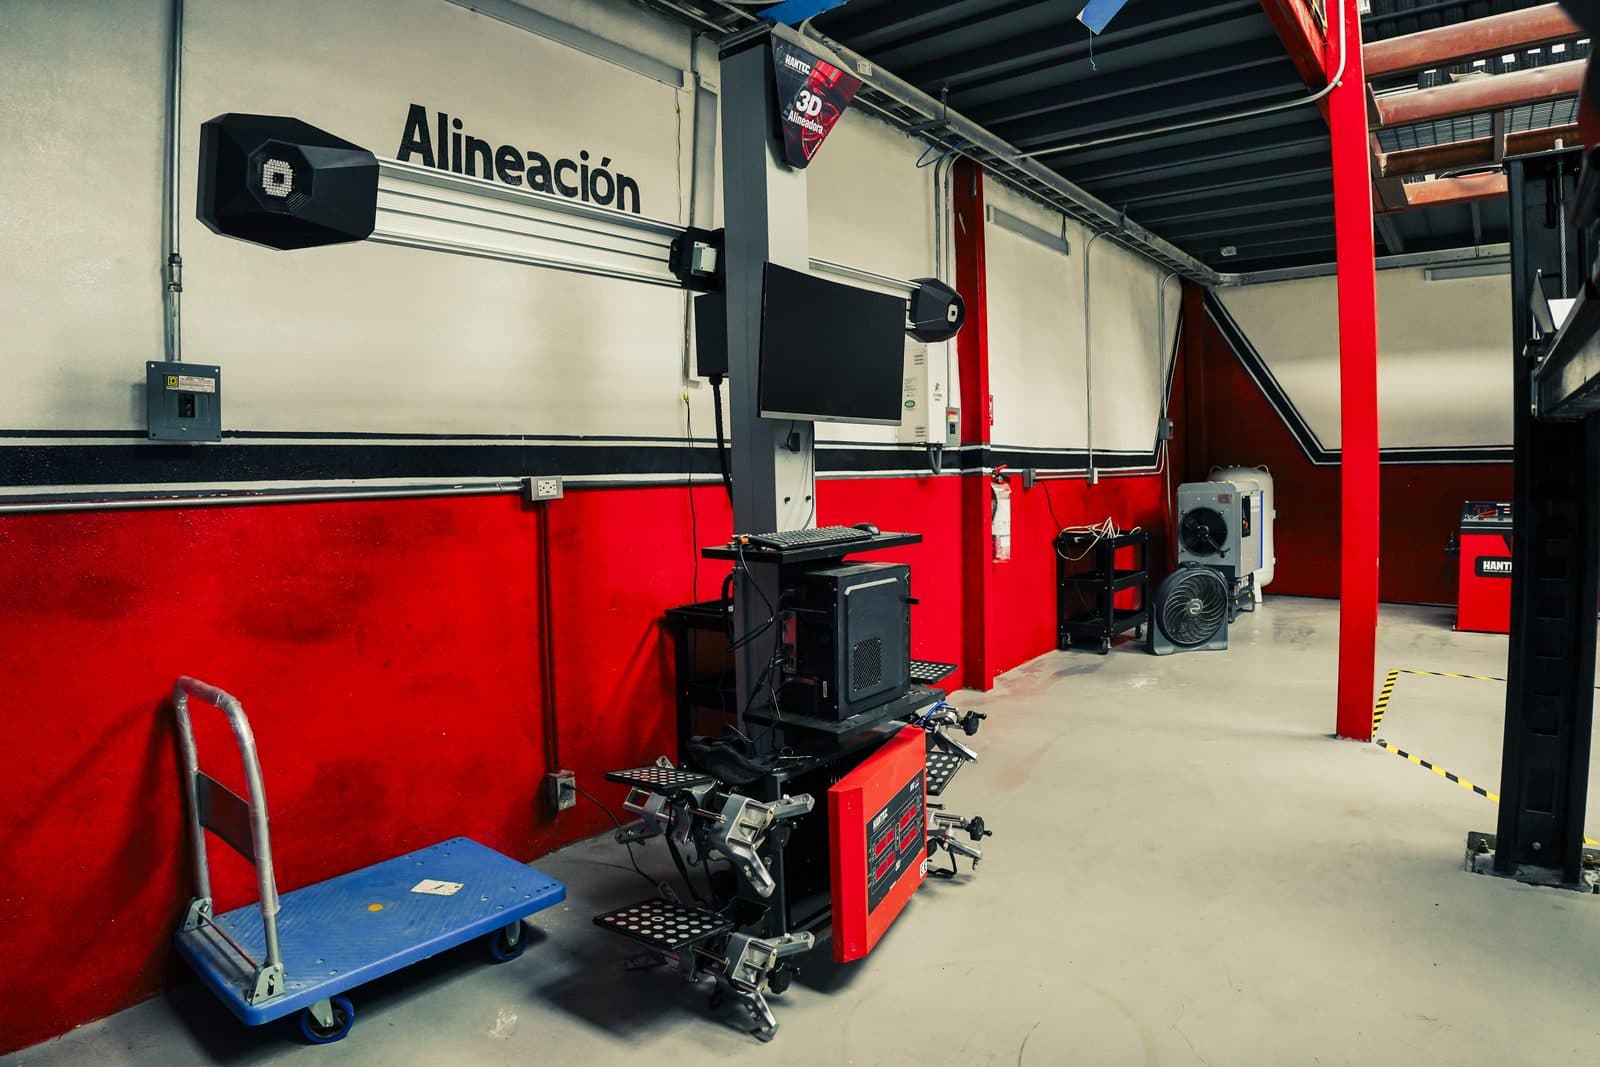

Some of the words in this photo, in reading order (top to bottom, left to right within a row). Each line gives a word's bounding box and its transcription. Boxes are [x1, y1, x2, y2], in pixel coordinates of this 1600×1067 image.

[785, 54, 811, 74] HANTEC
[796, 90, 823, 116] 3D
[788, 110, 824, 134] Alineadora
[396, 103, 641, 214] Alineación
